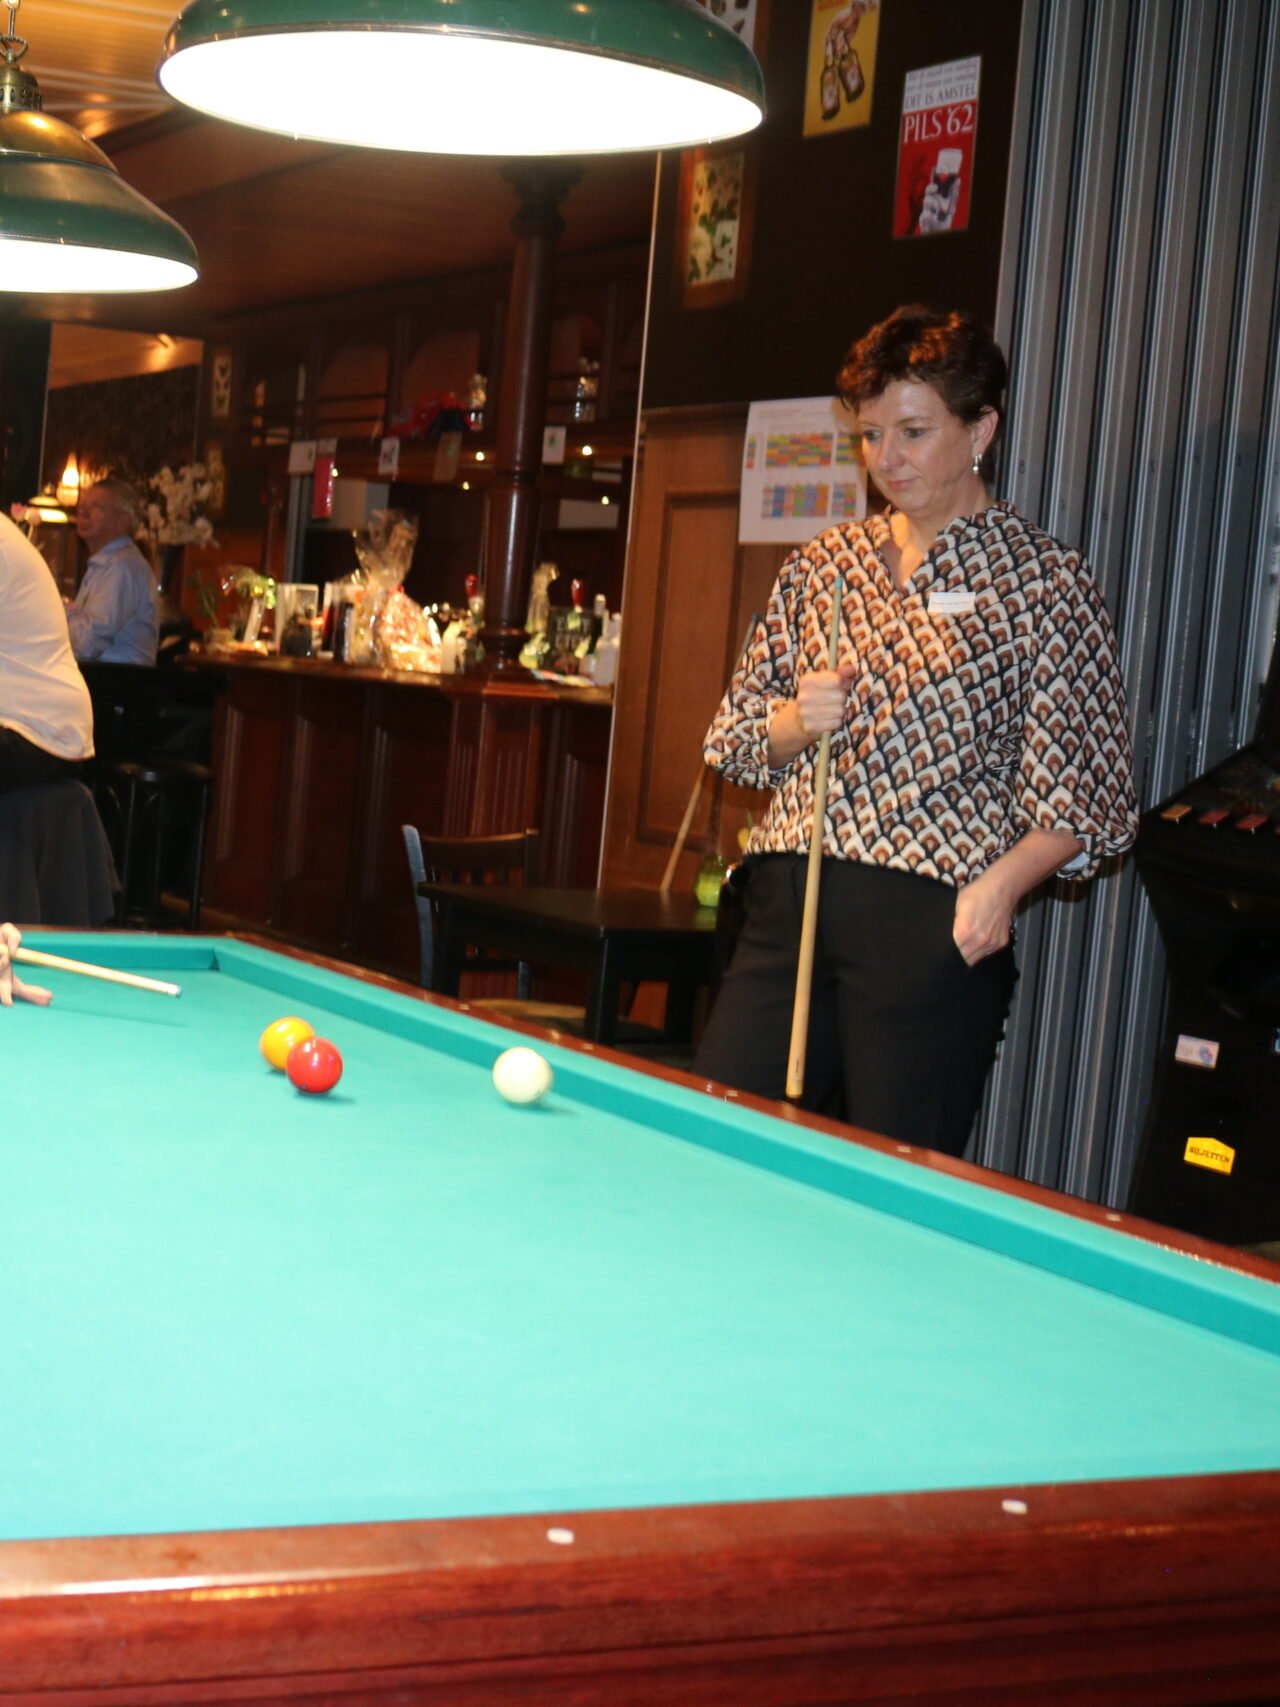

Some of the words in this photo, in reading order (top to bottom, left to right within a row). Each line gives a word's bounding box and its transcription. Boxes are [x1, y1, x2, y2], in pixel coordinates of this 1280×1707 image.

[925, 91, 934, 105] IS
[937, 82, 976, 103] AMSTEL
[903, 109, 942, 145] PILS
[1189, 1146, 1230, 1163] BILJETTEN
